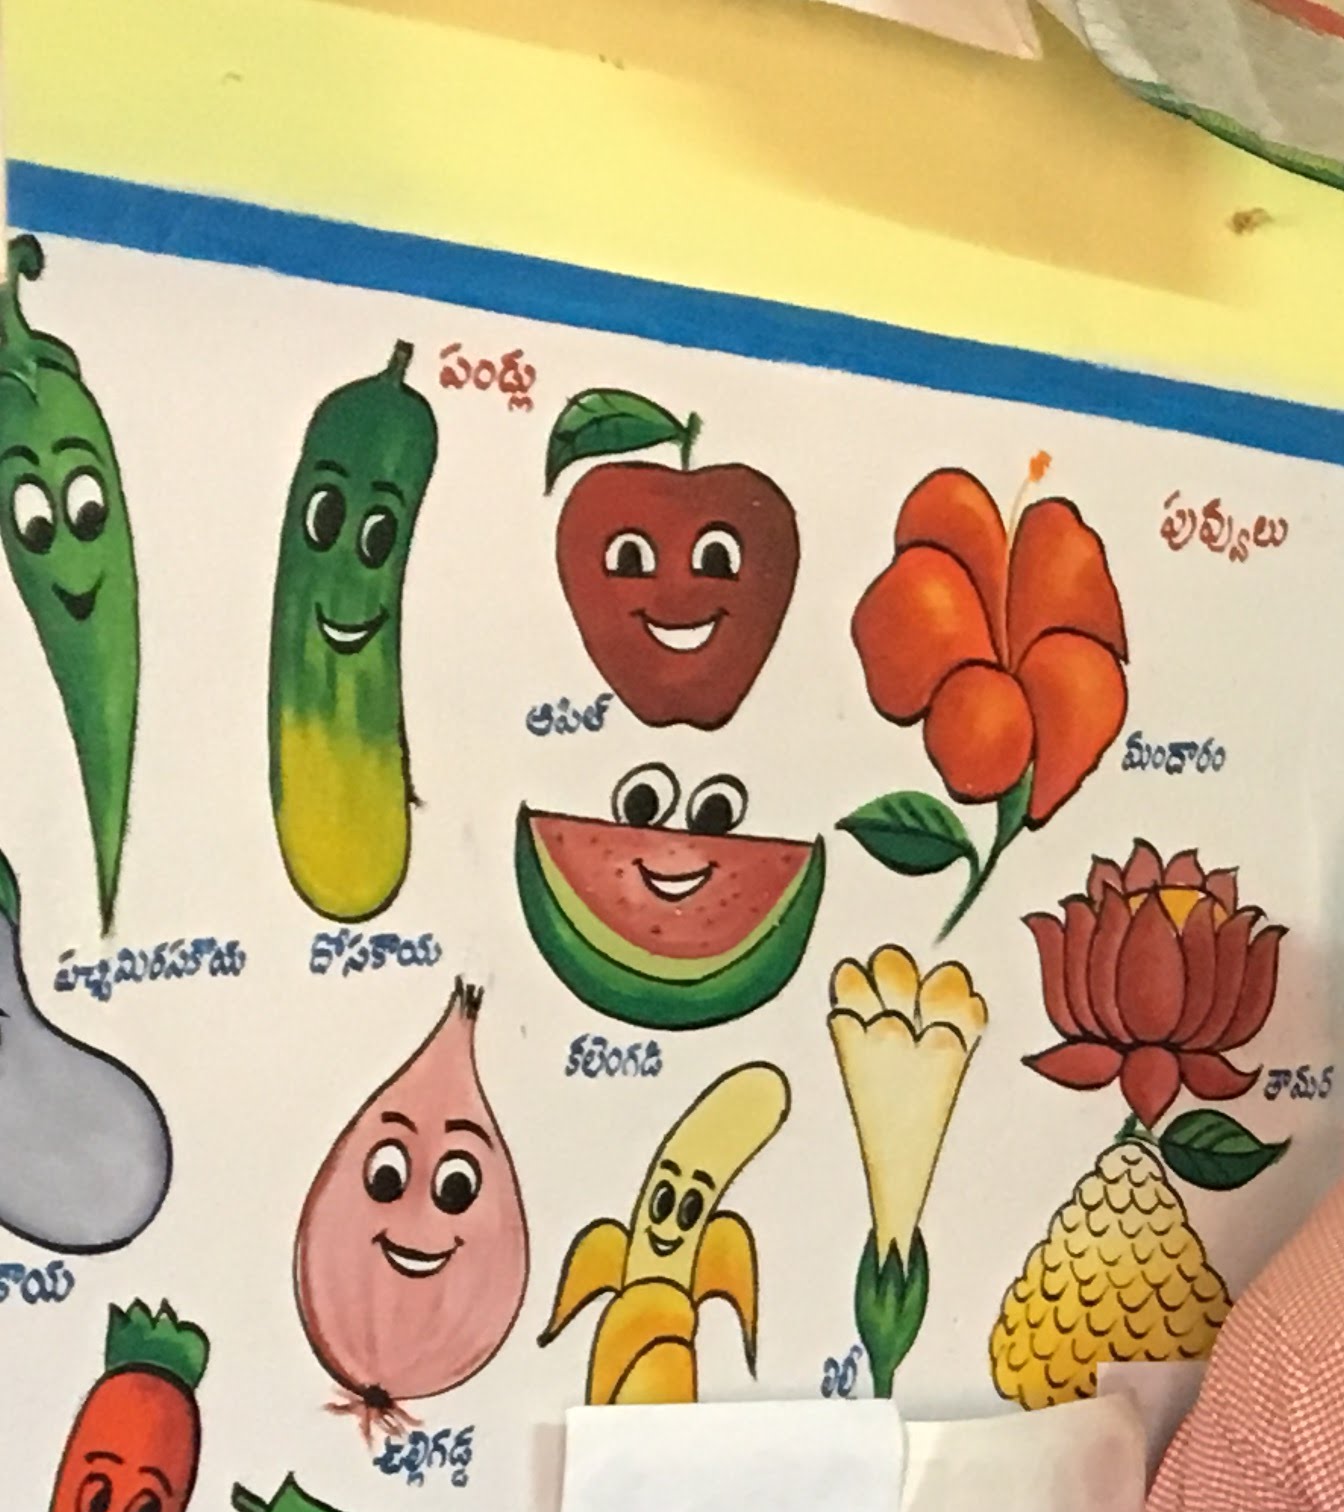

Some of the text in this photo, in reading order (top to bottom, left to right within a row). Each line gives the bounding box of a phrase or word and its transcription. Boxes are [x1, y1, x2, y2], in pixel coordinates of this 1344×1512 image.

[439, 343, 537, 411] పండ్లు
[1160, 490, 1289, 563] పువ్వులు
[1122, 730, 1227, 775] మందారం
[309, 928, 443, 976] దోసకాయ
